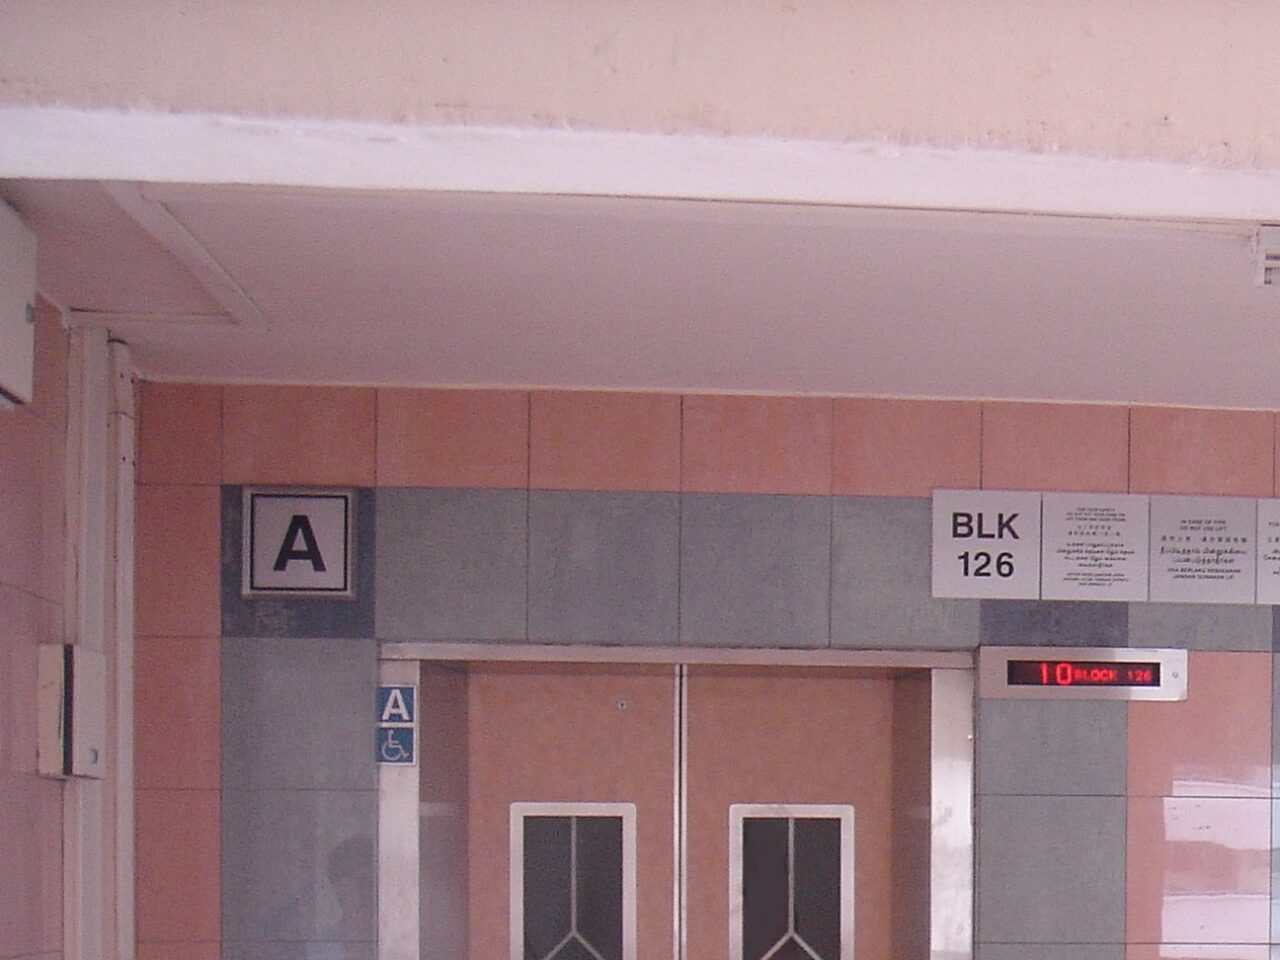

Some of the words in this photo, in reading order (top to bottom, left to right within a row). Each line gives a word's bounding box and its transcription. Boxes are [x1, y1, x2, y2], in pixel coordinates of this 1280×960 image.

[951, 512, 1020, 540] BLK
[272, 514, 327, 572] A
[957, 551, 1015, 578] 126
[1040, 662, 1072, 685] 10
[1073, 667, 1118, 683] BLOCK
[1127, 669, 1153, 683] 126
[381, 689, 410, 721] A
